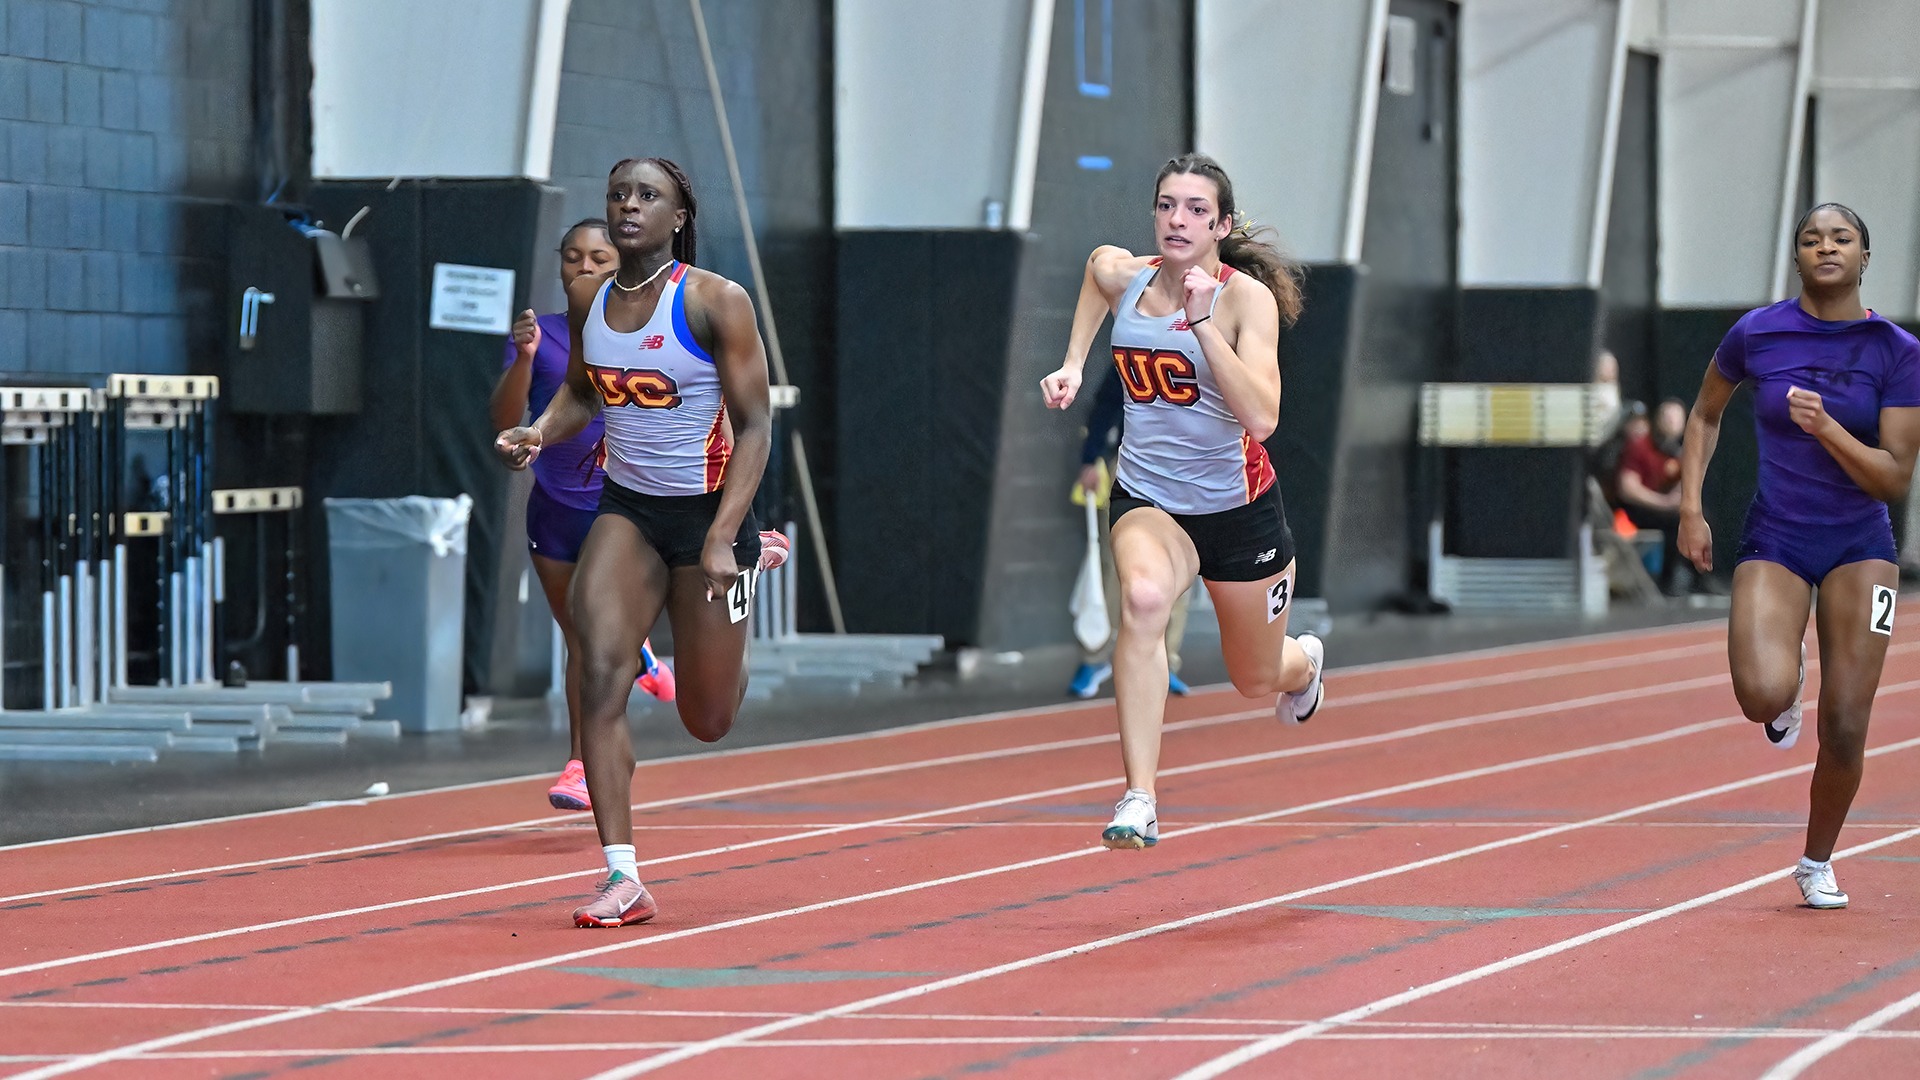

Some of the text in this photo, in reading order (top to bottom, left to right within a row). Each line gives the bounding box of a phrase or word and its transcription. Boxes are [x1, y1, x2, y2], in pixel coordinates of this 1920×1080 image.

[585, 367, 684, 409] UC
[1112, 345, 1201, 407] UC
[733, 574, 747, 616] 4
[1271, 578, 1288, 616] 3
[1876, 589, 1892, 632] 2
